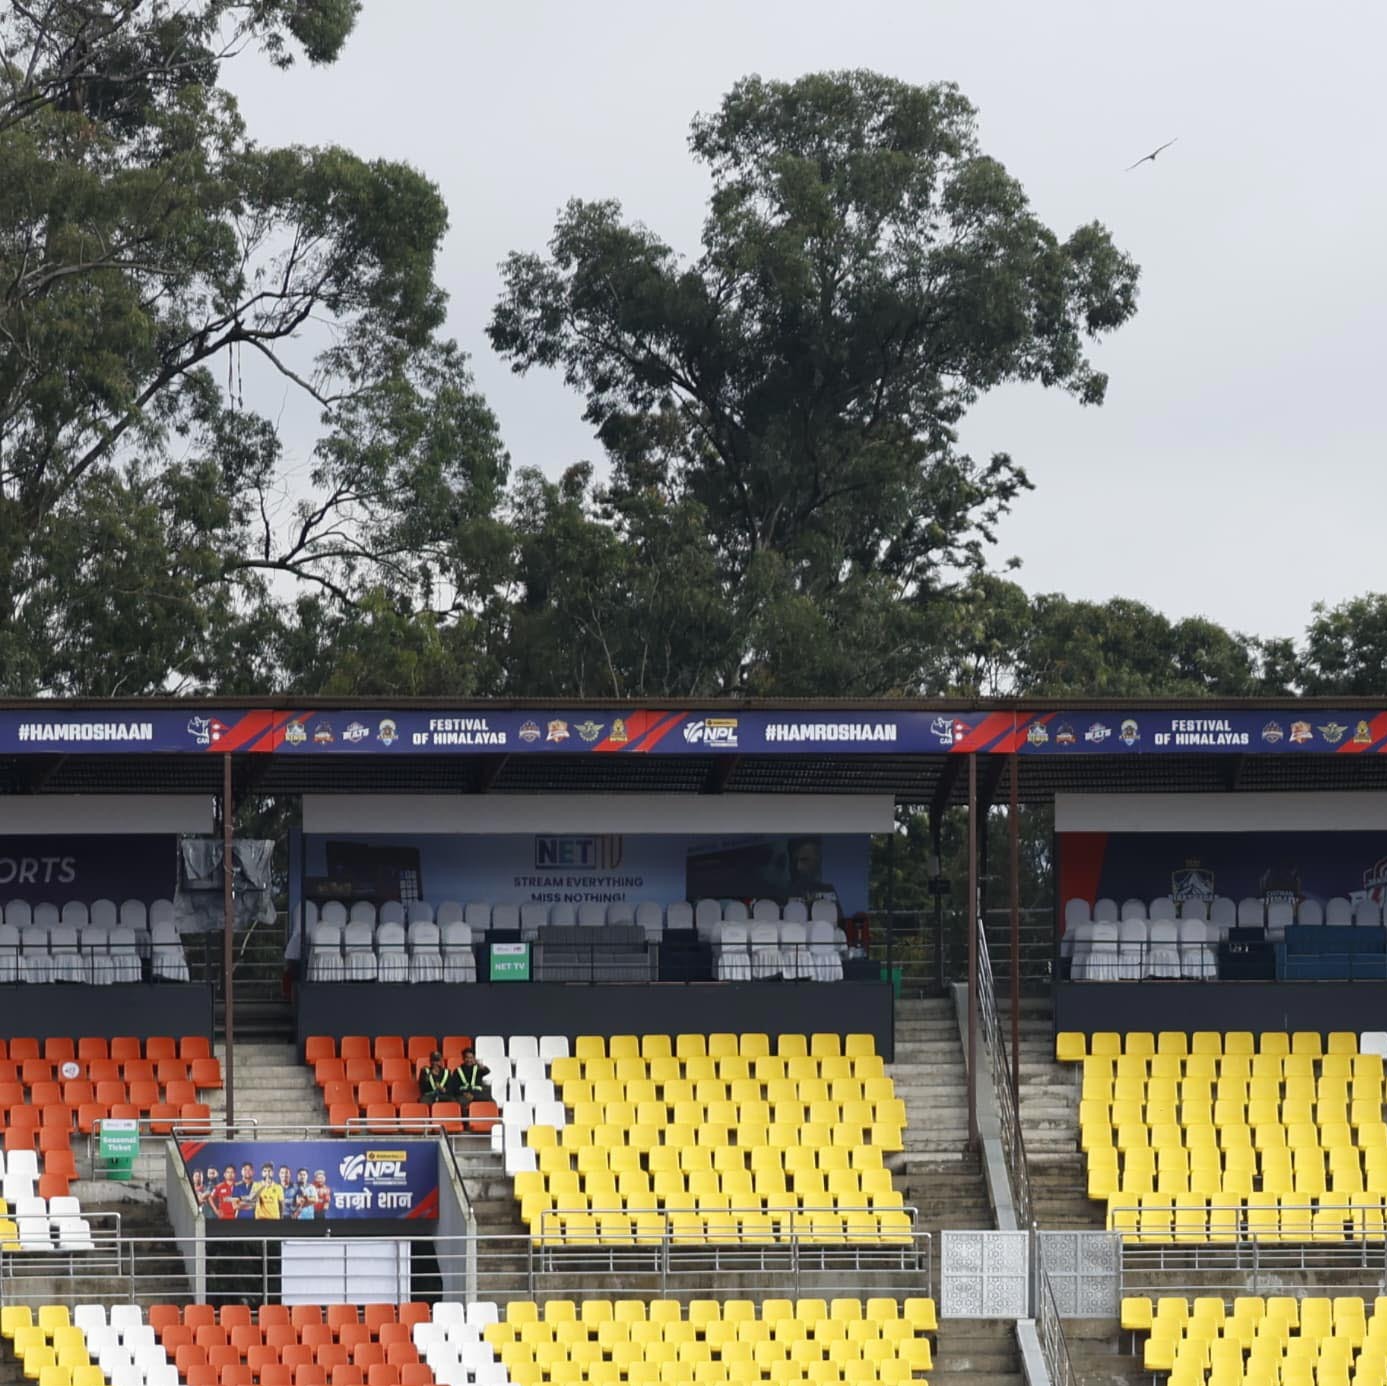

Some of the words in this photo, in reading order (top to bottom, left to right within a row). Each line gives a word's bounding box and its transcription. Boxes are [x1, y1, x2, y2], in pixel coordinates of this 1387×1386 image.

[430, 719, 489, 731] FESTIVAL
[1172, 720, 1231, 731] FESTIVAL
[19, 723, 152, 741] #HAMROSHAAN
[704, 728, 738, 740] NPL
[765, 724, 897, 741] #HAMROSHAAN
[412, 733, 428, 745] OF
[433, 733, 506, 745] HIMALAYAS
[1155, 733, 1171, 745] OF
[1176, 733, 1249, 744] HIMALAYAS
[538, 840, 592, 864] NET
[514, 877, 563, 887] STREAM
[566, 876, 643, 887] EVERYTHING
[532, 893, 561, 902] MISS
[513, 962, 525, 970] TV
[364, 1161, 406, 1177] NPL
[334, 1187, 372, 1210] हाम्रो
[378, 1191, 413, 1208] शान
